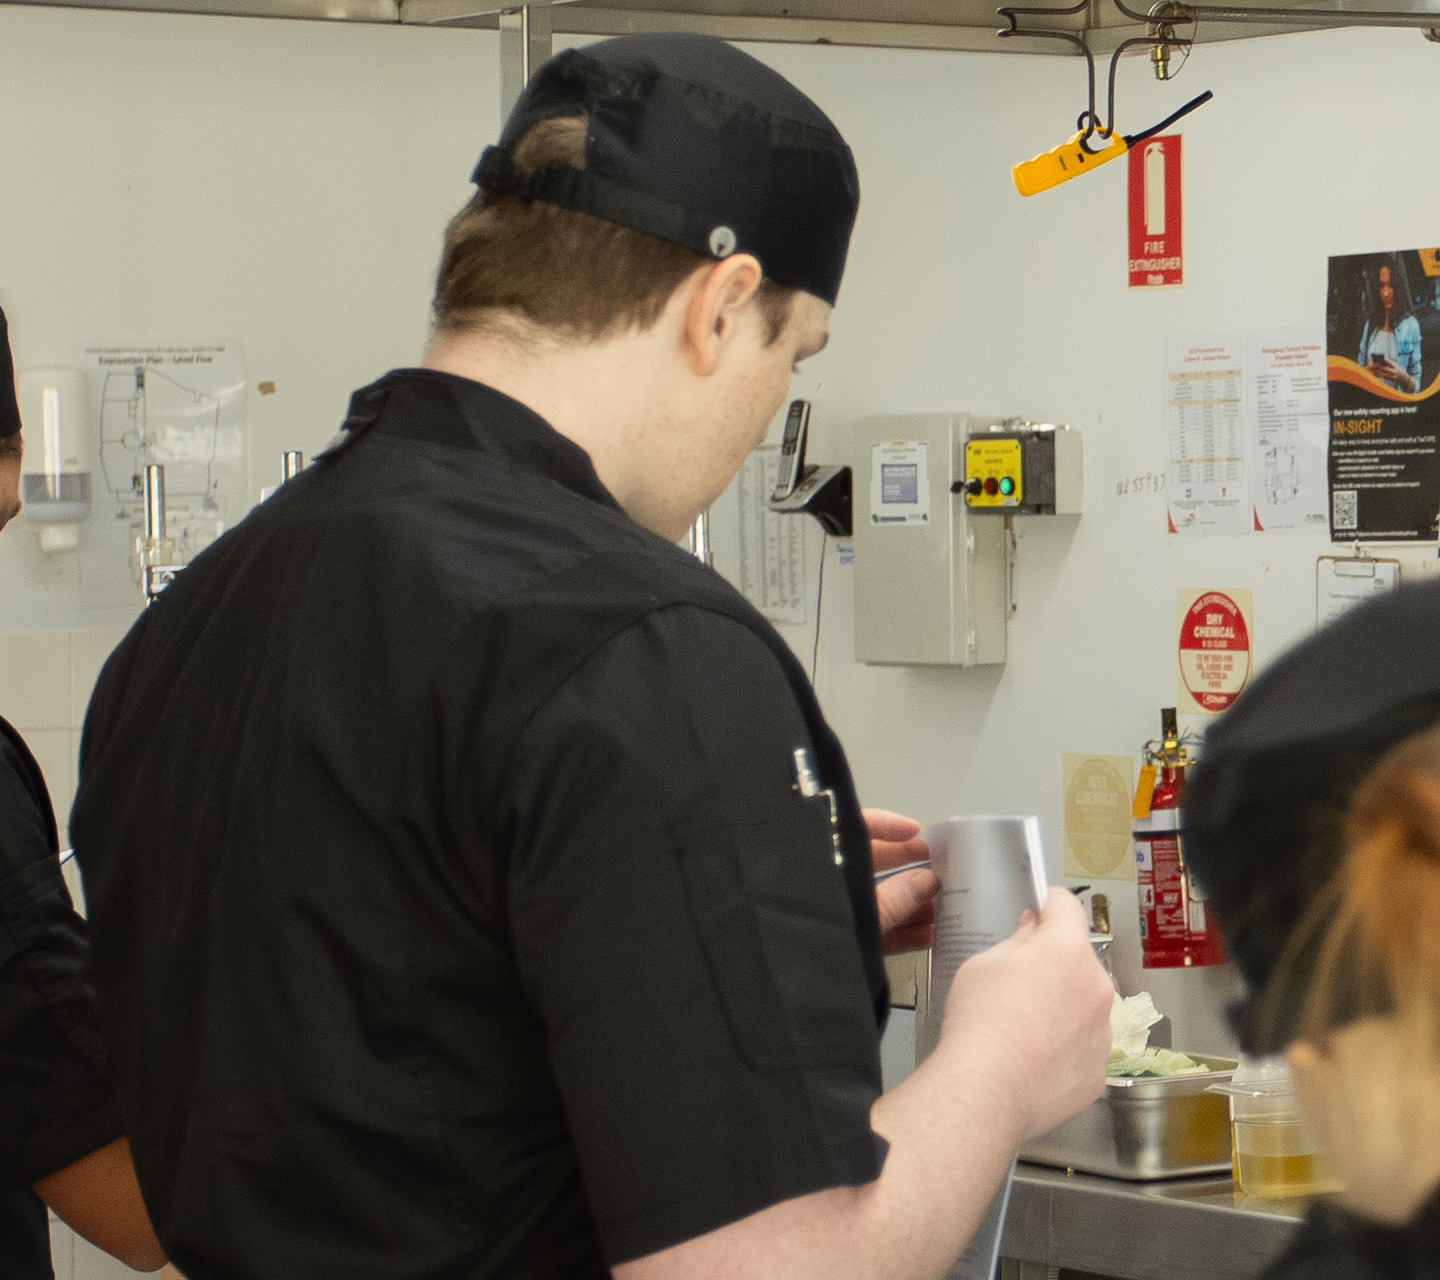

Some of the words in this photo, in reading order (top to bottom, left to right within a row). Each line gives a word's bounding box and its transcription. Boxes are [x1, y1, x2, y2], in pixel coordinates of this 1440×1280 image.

[1144, 241, 1165, 254] FIRE
[1129, 257, 1181, 272] EXTINGUISHER
[1333, 418, 1383, 435] IN-SIGHT
